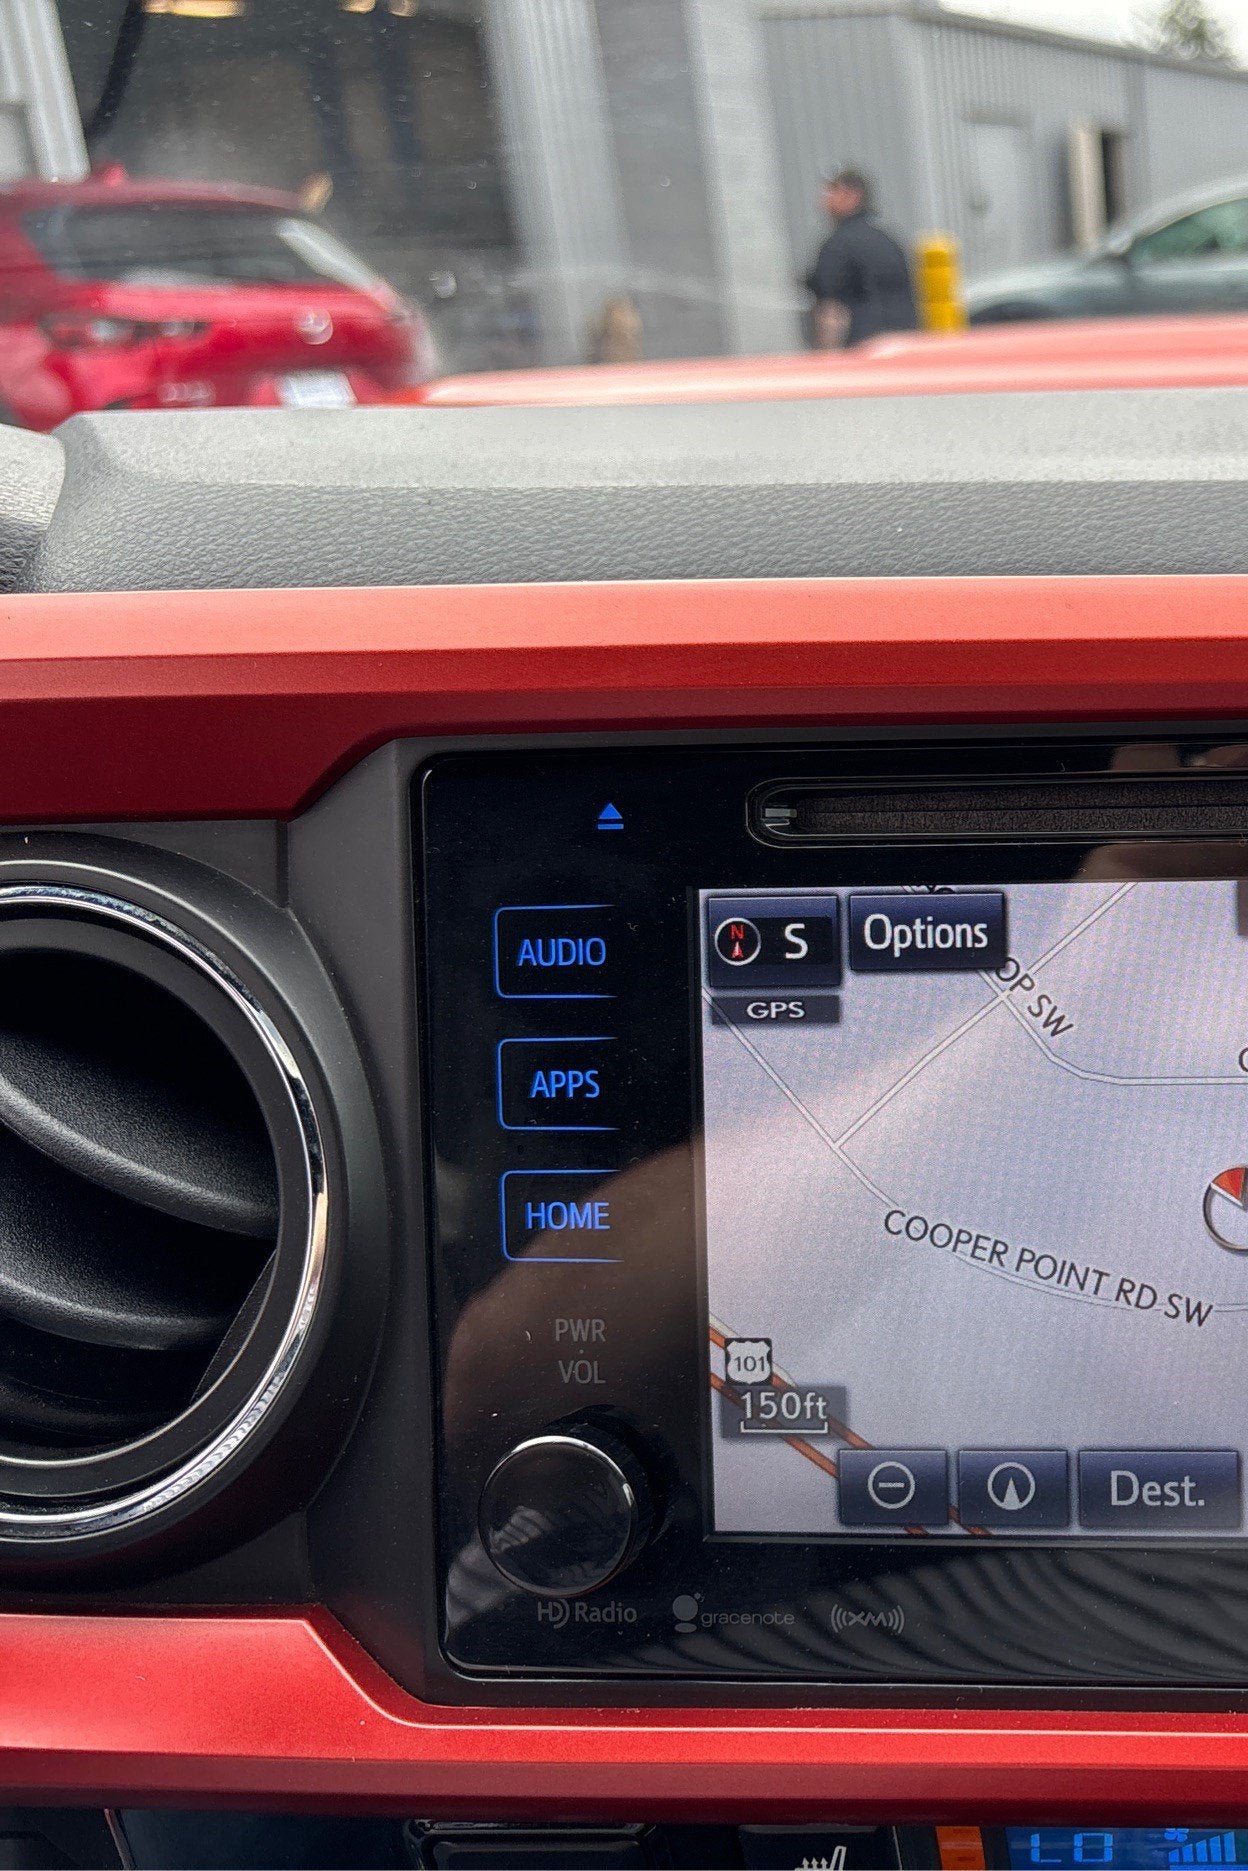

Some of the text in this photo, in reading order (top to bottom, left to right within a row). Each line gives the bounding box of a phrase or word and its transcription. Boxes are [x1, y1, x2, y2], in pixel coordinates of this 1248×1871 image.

[730, 923, 746, 938] N
[784, 922, 808, 959] S
[863, 913, 988, 956] Options
[517, 937, 607, 968] AUDIO
[746, 1000, 806, 1020] GPS
[1027, 994, 1074, 1037] SW
[529, 1070, 600, 1100] APPS
[525, 1201, 611, 1230] HOME
[883, 1209, 1214, 1328] COOPER POINT RD SW
[554, 1318, 607, 1343] PWR
[558, 1358, 607, 1385] VOL
[734, 1354, 765, 1373] 101
[740, 1391, 828, 1421] 150ft
[1110, 1469, 1206, 1508] Dest.
[574, 1601, 638, 1624] Radio
[701, 1609, 796, 1627] gracenote
